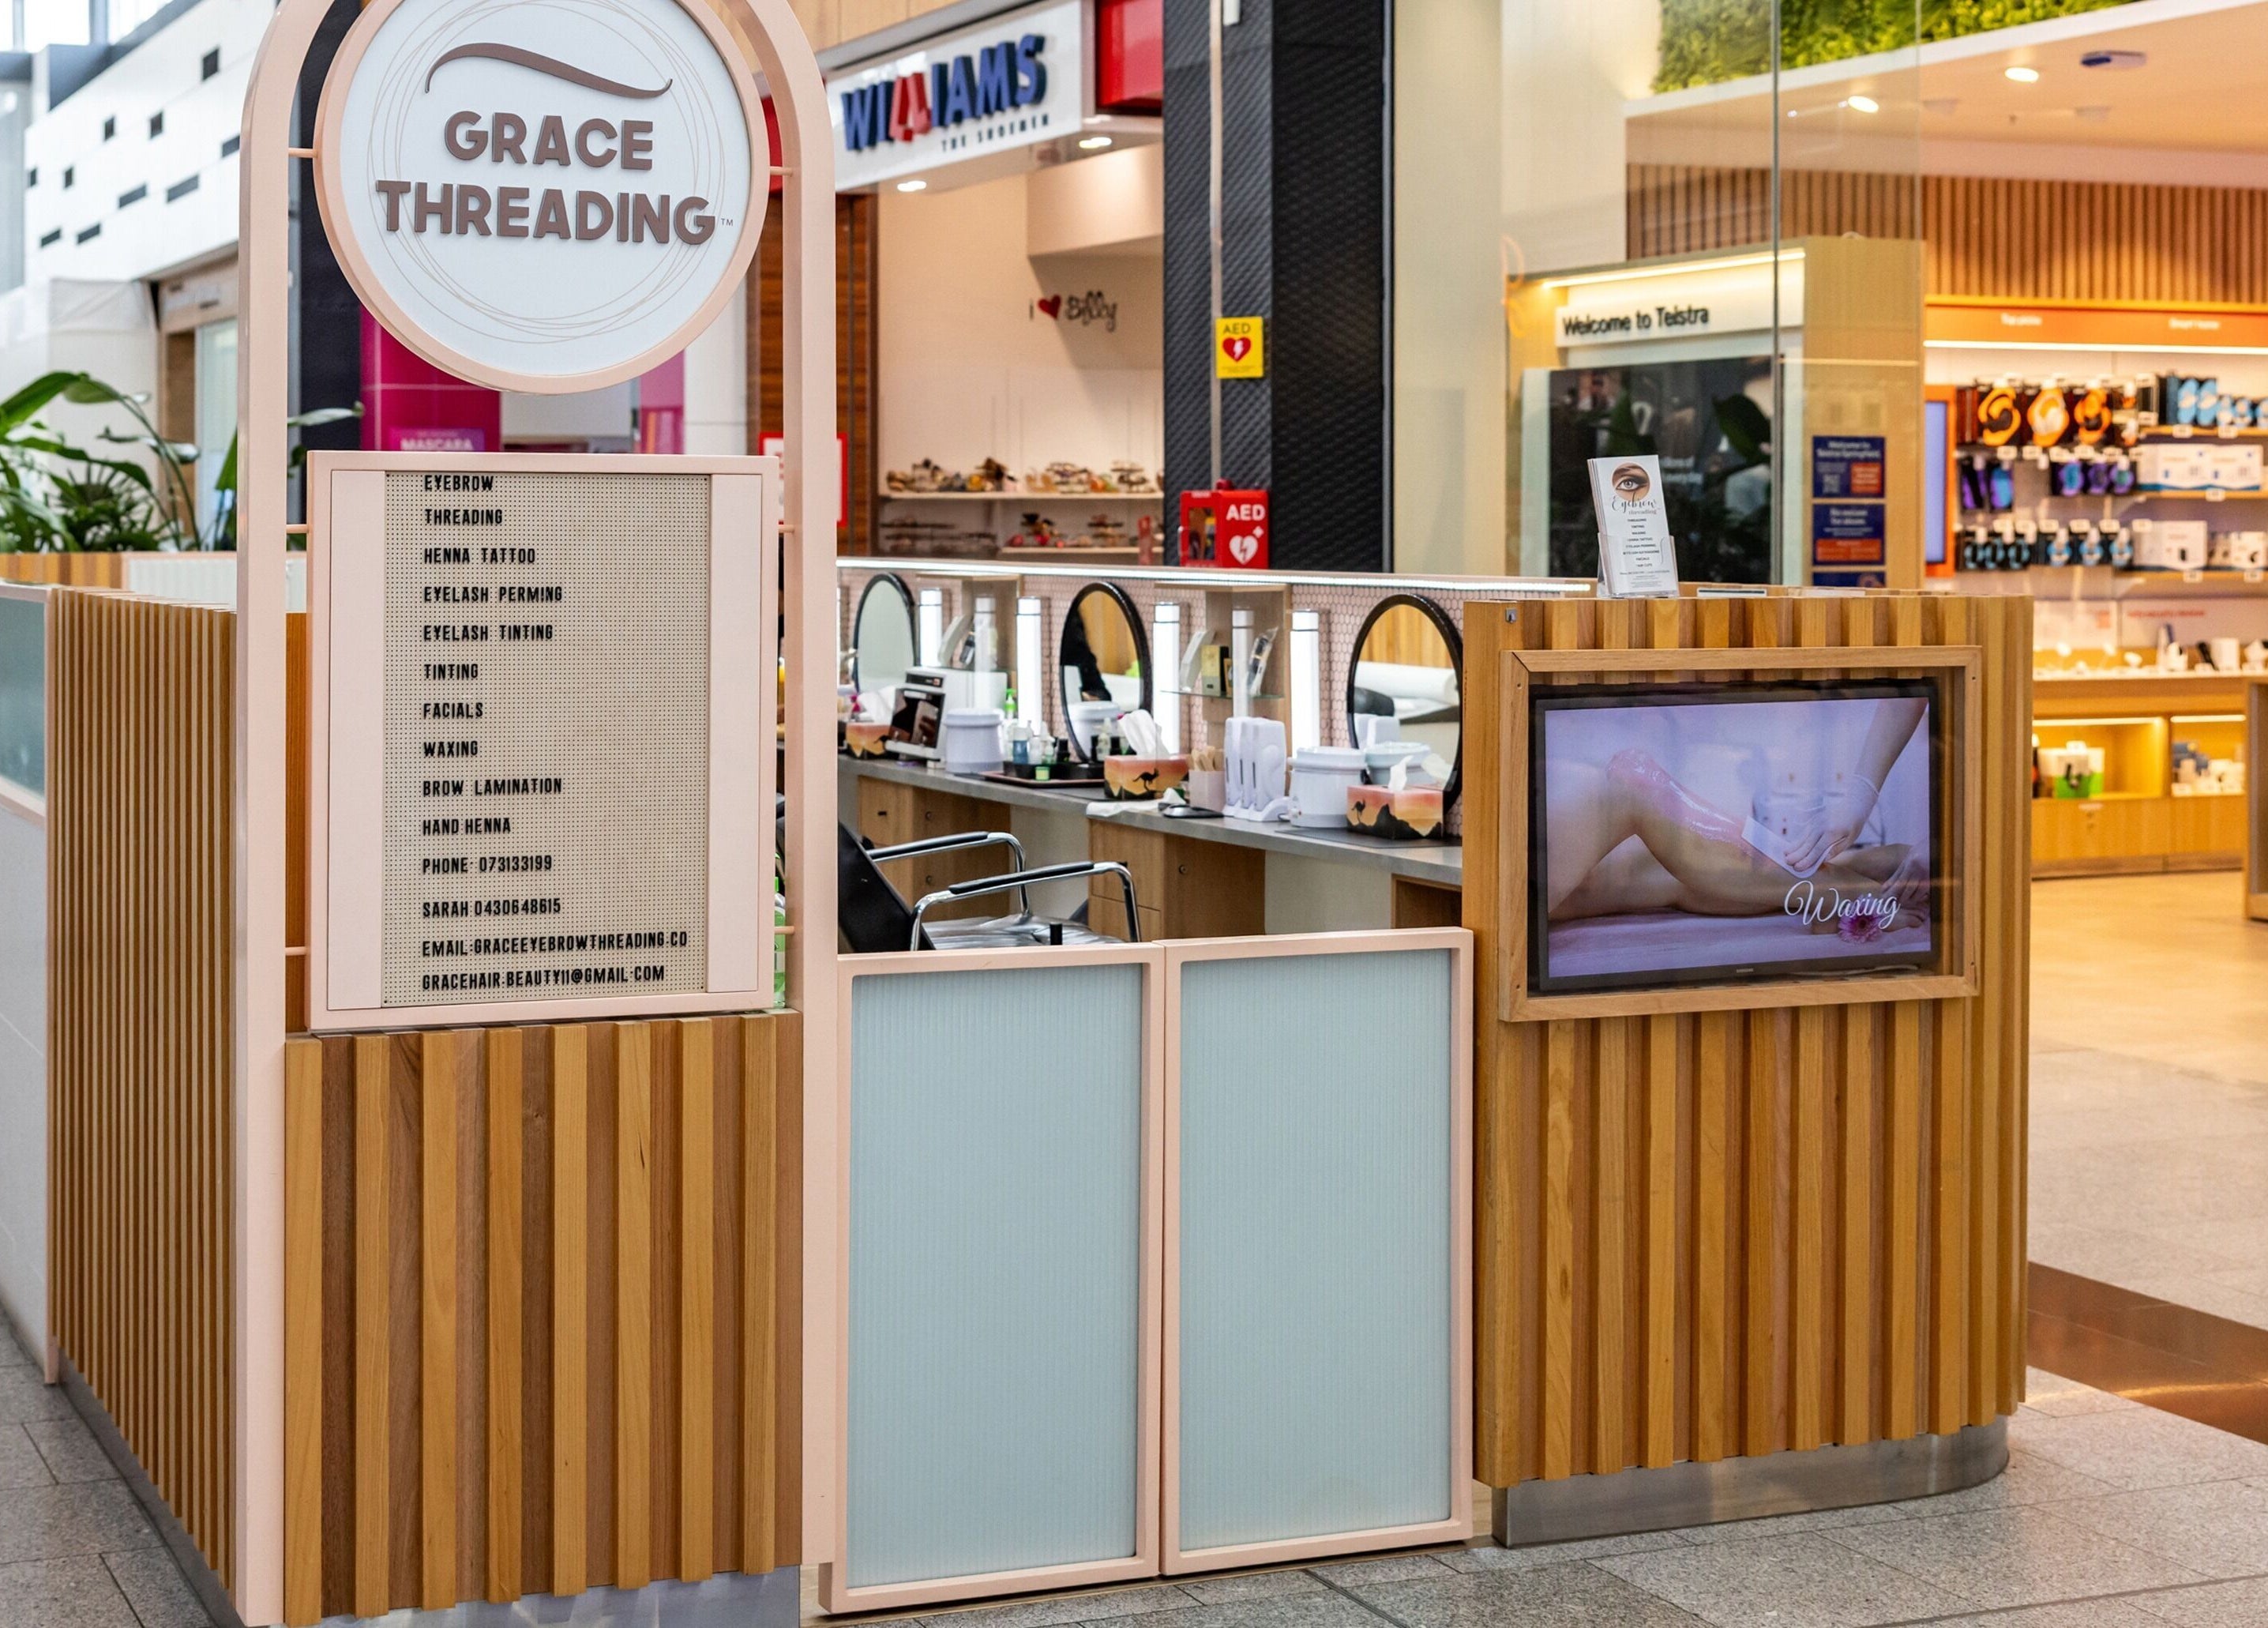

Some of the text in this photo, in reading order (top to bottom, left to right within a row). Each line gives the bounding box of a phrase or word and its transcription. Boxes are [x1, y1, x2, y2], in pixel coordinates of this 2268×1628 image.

[841, 32, 1046, 152] WILLIAMS
[445, 110, 653, 171] GRACE
[376, 179, 715, 246] THREADING
[1223, 322, 1252, 335] AED
[1563, 304, 1709, 336] Welcome to Telstra
[424, 475, 494, 491] EYEBROW
[425, 509, 503, 525] THREADING
[1226, 504, 1266, 521] AED
[424, 547, 536, 564] HENNA TATTOO
[424, 586, 489, 603] EYELASH
[423, 624, 553, 641] EYELASH TINTING
[424, 664, 479, 681] TINTING
[423, 702, 483, 720] FACIALS
[423, 740, 479, 758] WAXING
[423, 778, 562, 798] BROW LAMINATION
[422, 818, 511, 836] HAND HENNA
[479, 855, 552, 873] 073133199
[422, 897, 561, 918] SARAH 0430648615
[1784, 880, 1901, 930] Waxing
